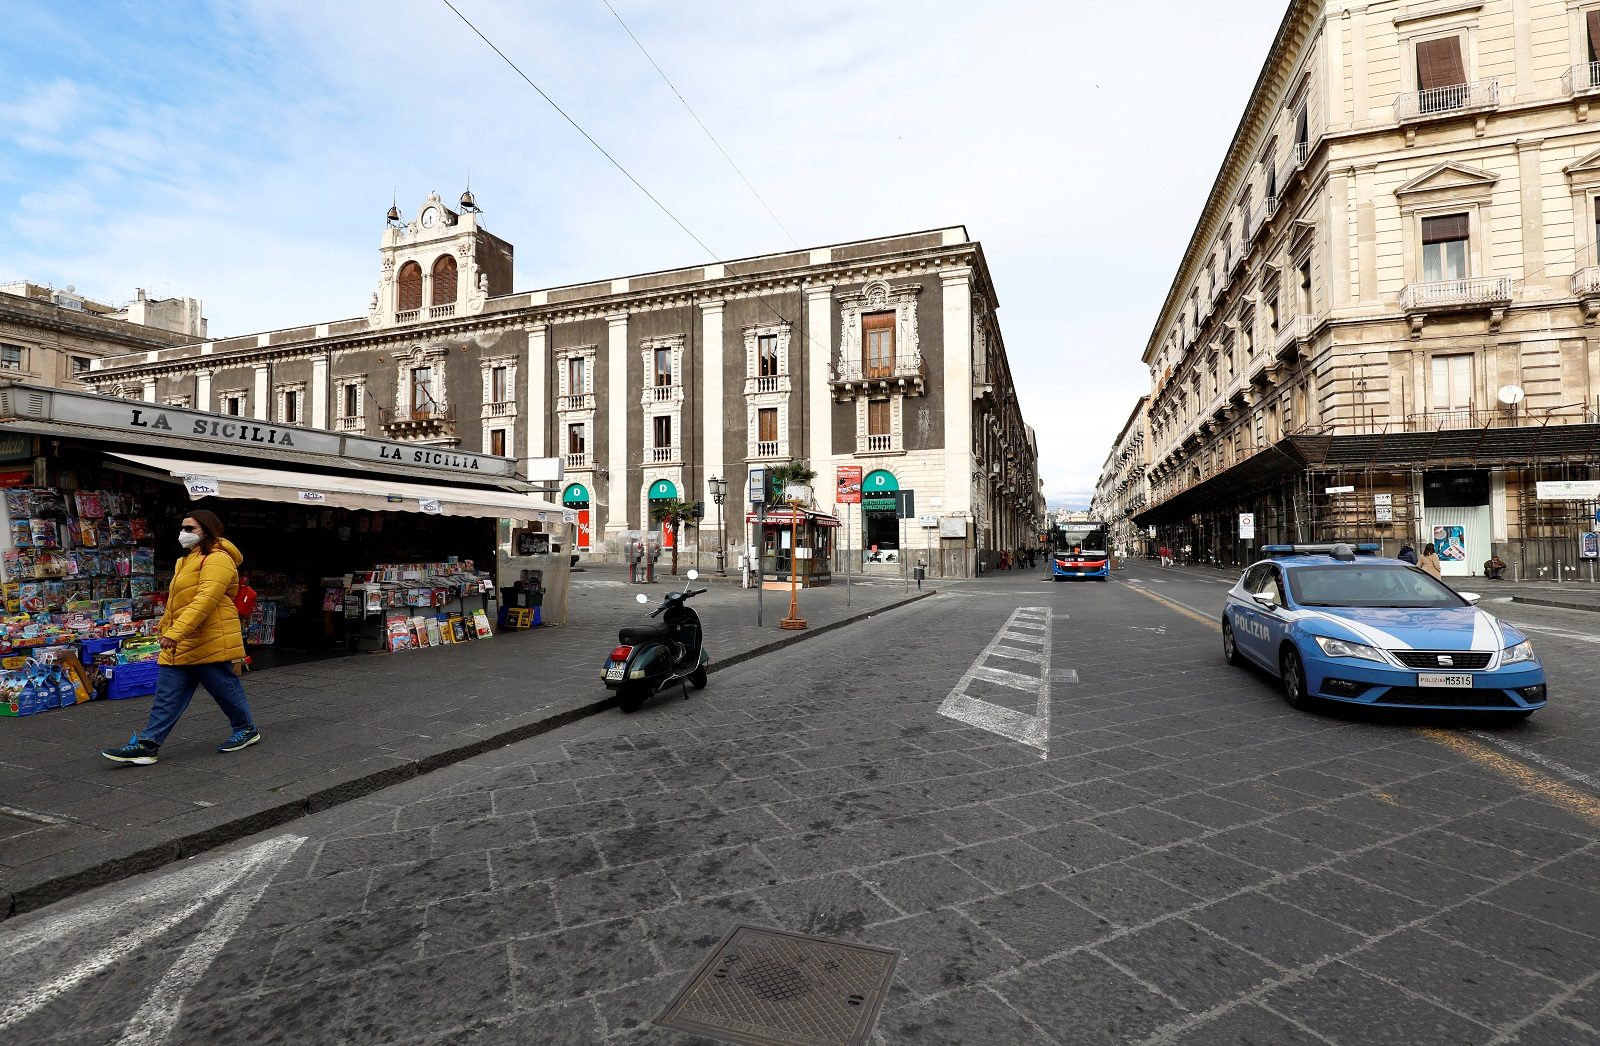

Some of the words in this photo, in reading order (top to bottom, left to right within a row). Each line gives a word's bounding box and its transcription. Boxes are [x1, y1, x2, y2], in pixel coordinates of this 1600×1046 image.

[131, 410, 172, 430] LA
[193, 419, 294, 446] SICILIA
[380, 446, 402, 460] LA
[414, 451, 479, 469] SICILIA
[876, 476, 885, 486] D
[573, 488, 580, 496] D
[660, 484, 668, 492] D
[1234, 614, 1270, 642] POLIZIA
[1446, 676, 1470, 686] M3315
